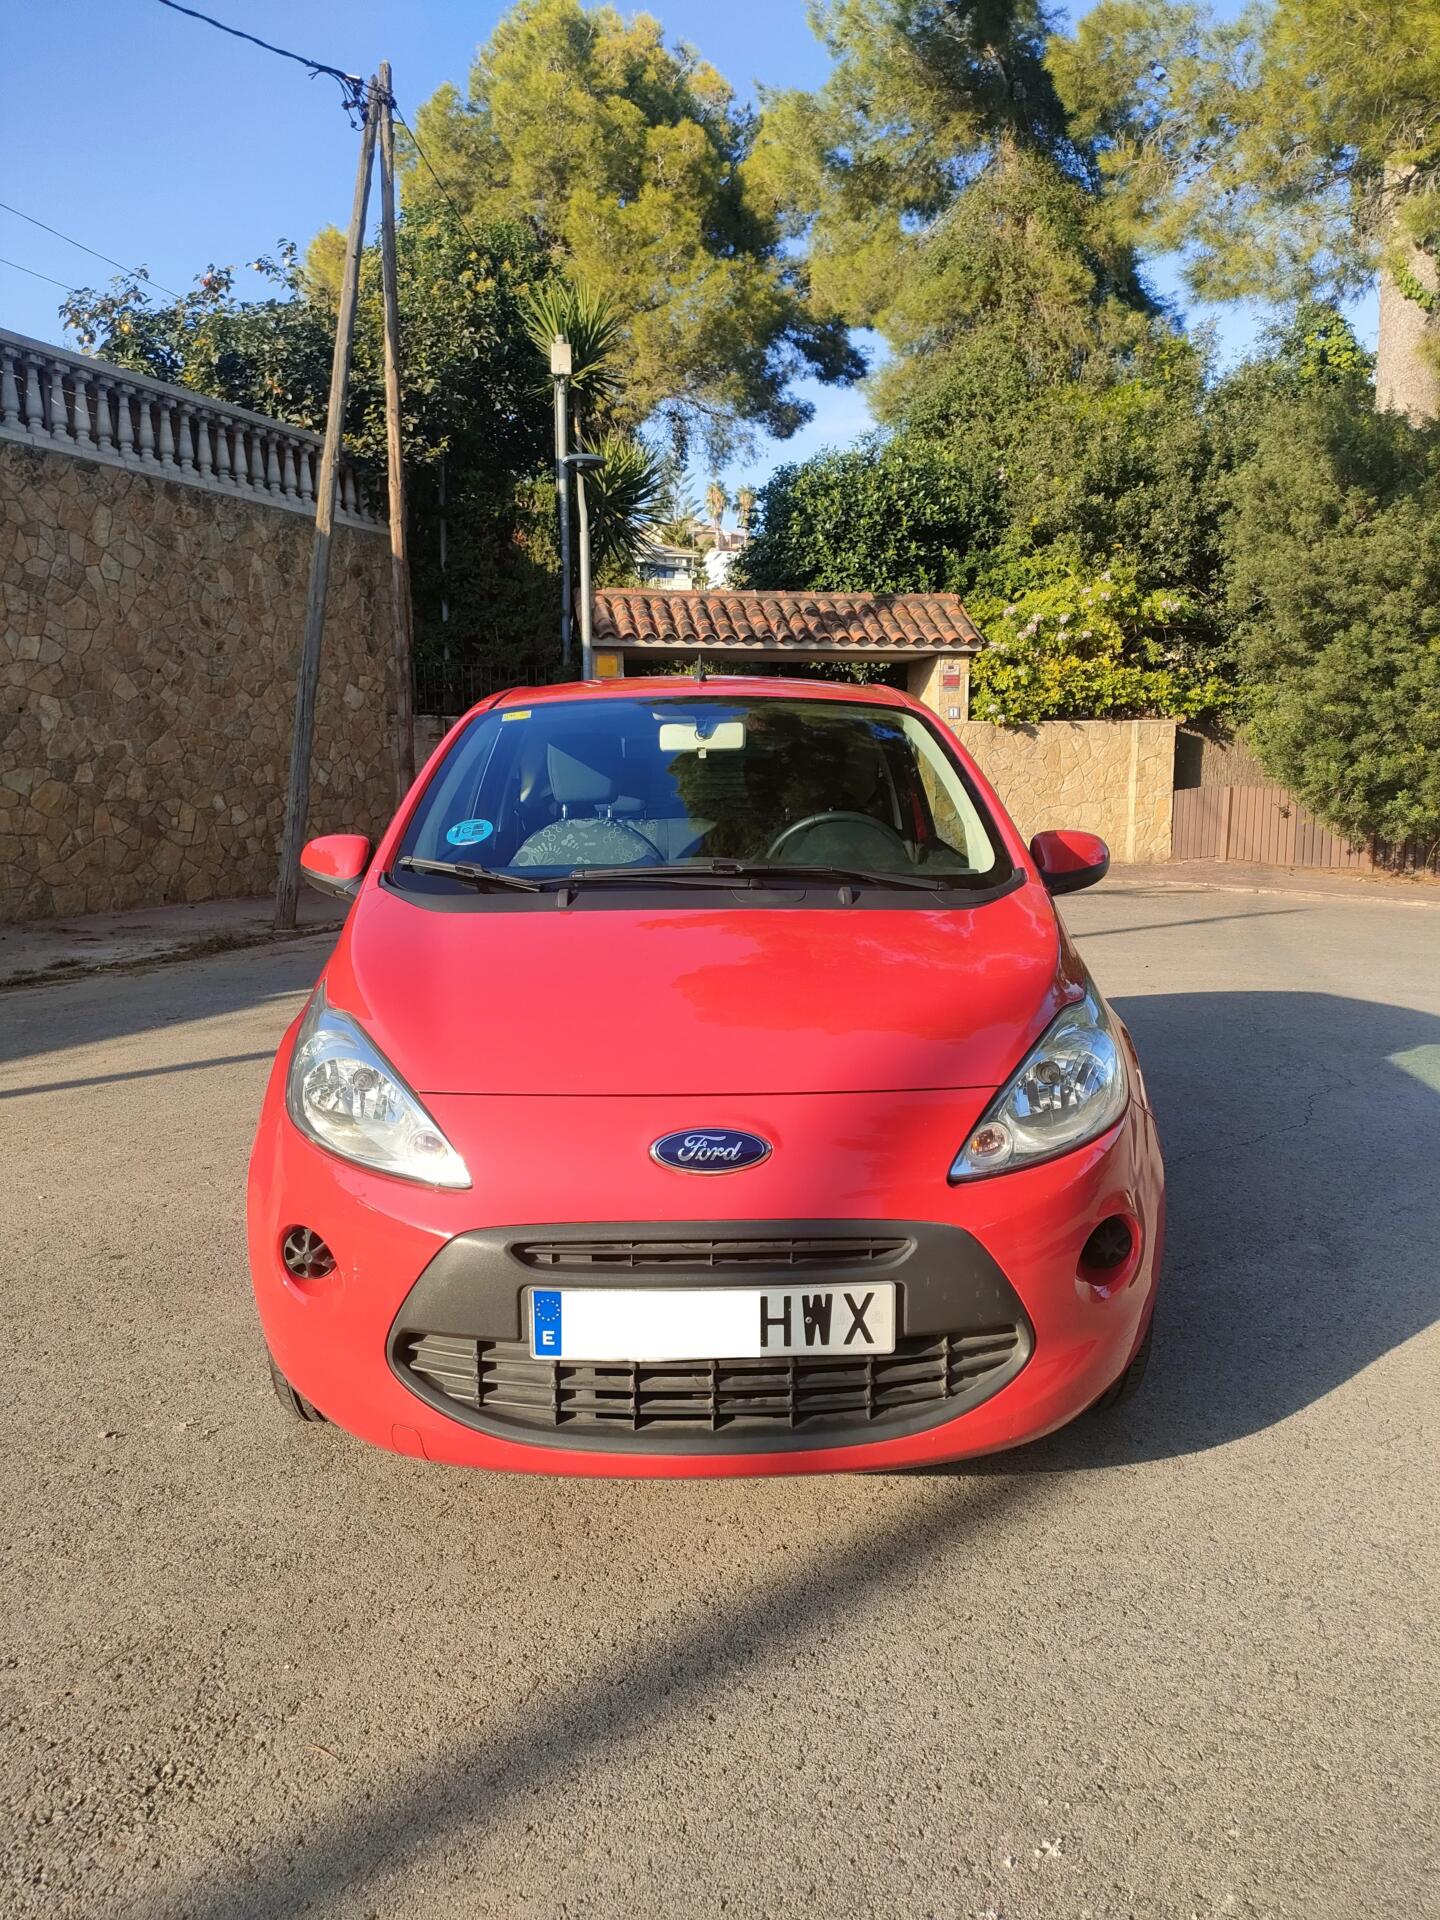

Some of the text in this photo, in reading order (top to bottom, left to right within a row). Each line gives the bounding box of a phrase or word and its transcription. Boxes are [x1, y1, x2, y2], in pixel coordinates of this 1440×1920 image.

[677, 1134, 743, 1161] Ford
[542, 1292, 875, 1348] E HWX
